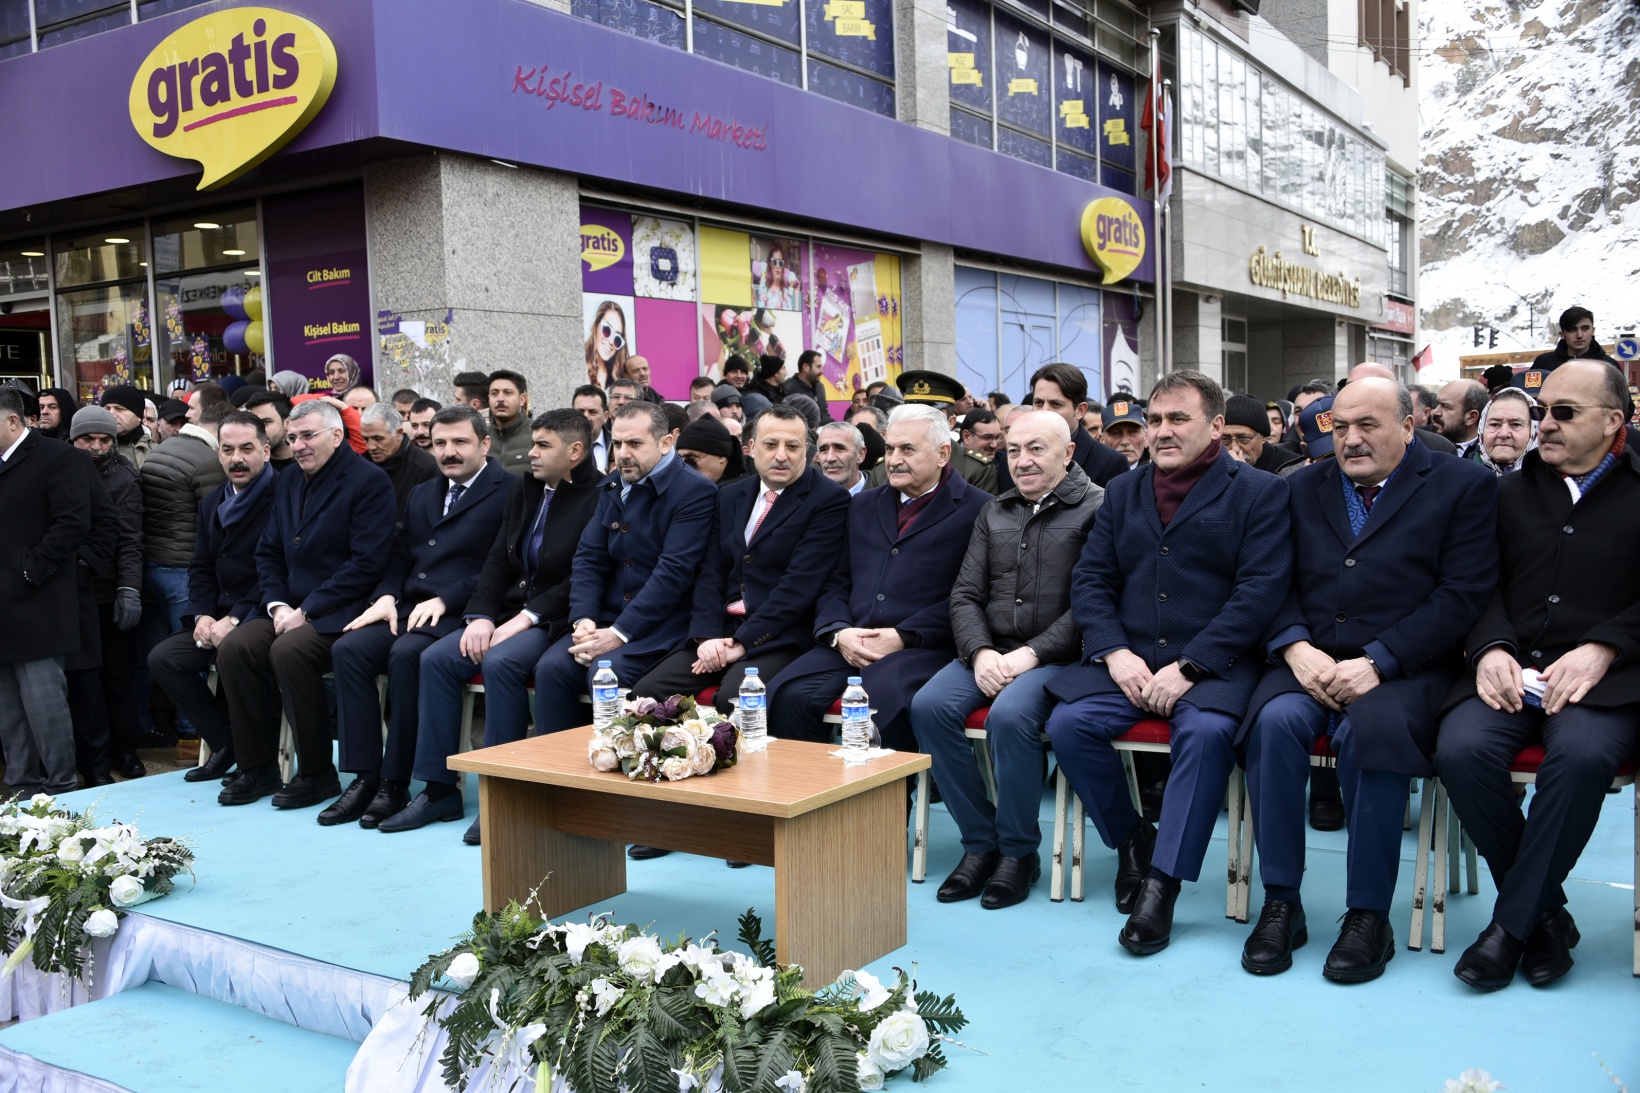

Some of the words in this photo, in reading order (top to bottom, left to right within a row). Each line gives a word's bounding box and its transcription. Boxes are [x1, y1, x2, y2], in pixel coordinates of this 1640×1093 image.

[841, 4, 853, 16] SAÇ
[842, 22, 862, 34] BAKIM
[147, 18, 301, 138] gratis
[512, 65, 603, 110] Kişisel
[609, 88, 686, 130] Bakım
[690, 112, 768, 152] Marketi
[1096, 211, 1140, 251] gratis
[307, 271, 322, 283] Cilt
[322, 267, 351, 282] Bakım
[304, 322, 331, 339] Kişisel
[331, 320, 360, 335] Bakım
[426, 324, 446, 334] ratis
